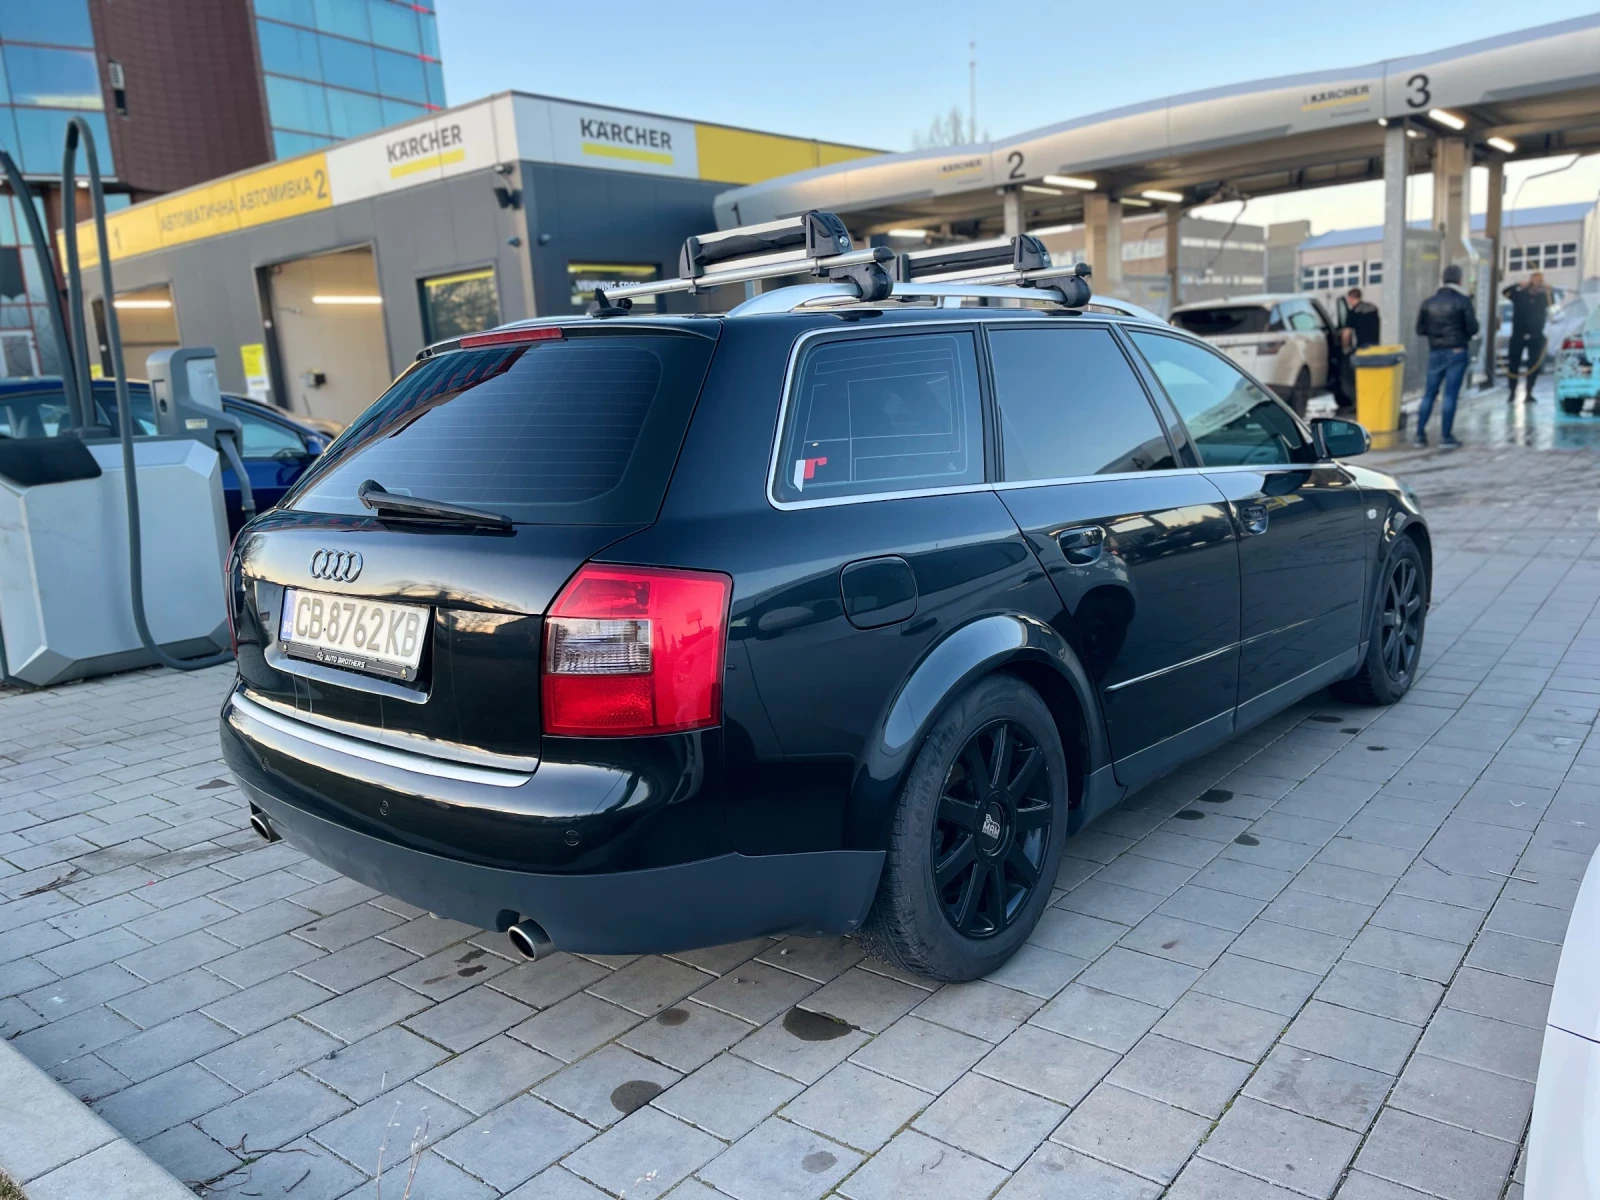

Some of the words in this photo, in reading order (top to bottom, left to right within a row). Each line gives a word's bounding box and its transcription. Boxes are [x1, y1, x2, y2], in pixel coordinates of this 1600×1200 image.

[1405, 73, 1431, 108] 3
[387, 124, 462, 163] KÄRCHER
[580, 117, 672, 150] KÄRCHER
[1007, 151, 1026, 179] 2
[161, 196, 237, 231] АВТОМАТИЧНА
[239, 176, 315, 212] АВТОМИВКА
[314, 169, 327, 199] 2
[731, 203, 742, 226] 1
[113, 226, 123, 250] 1
[283, 621, 293, 633] BG
[325, 654, 338, 663] AUTO
[337, 657, 366, 668] BROTHERS
